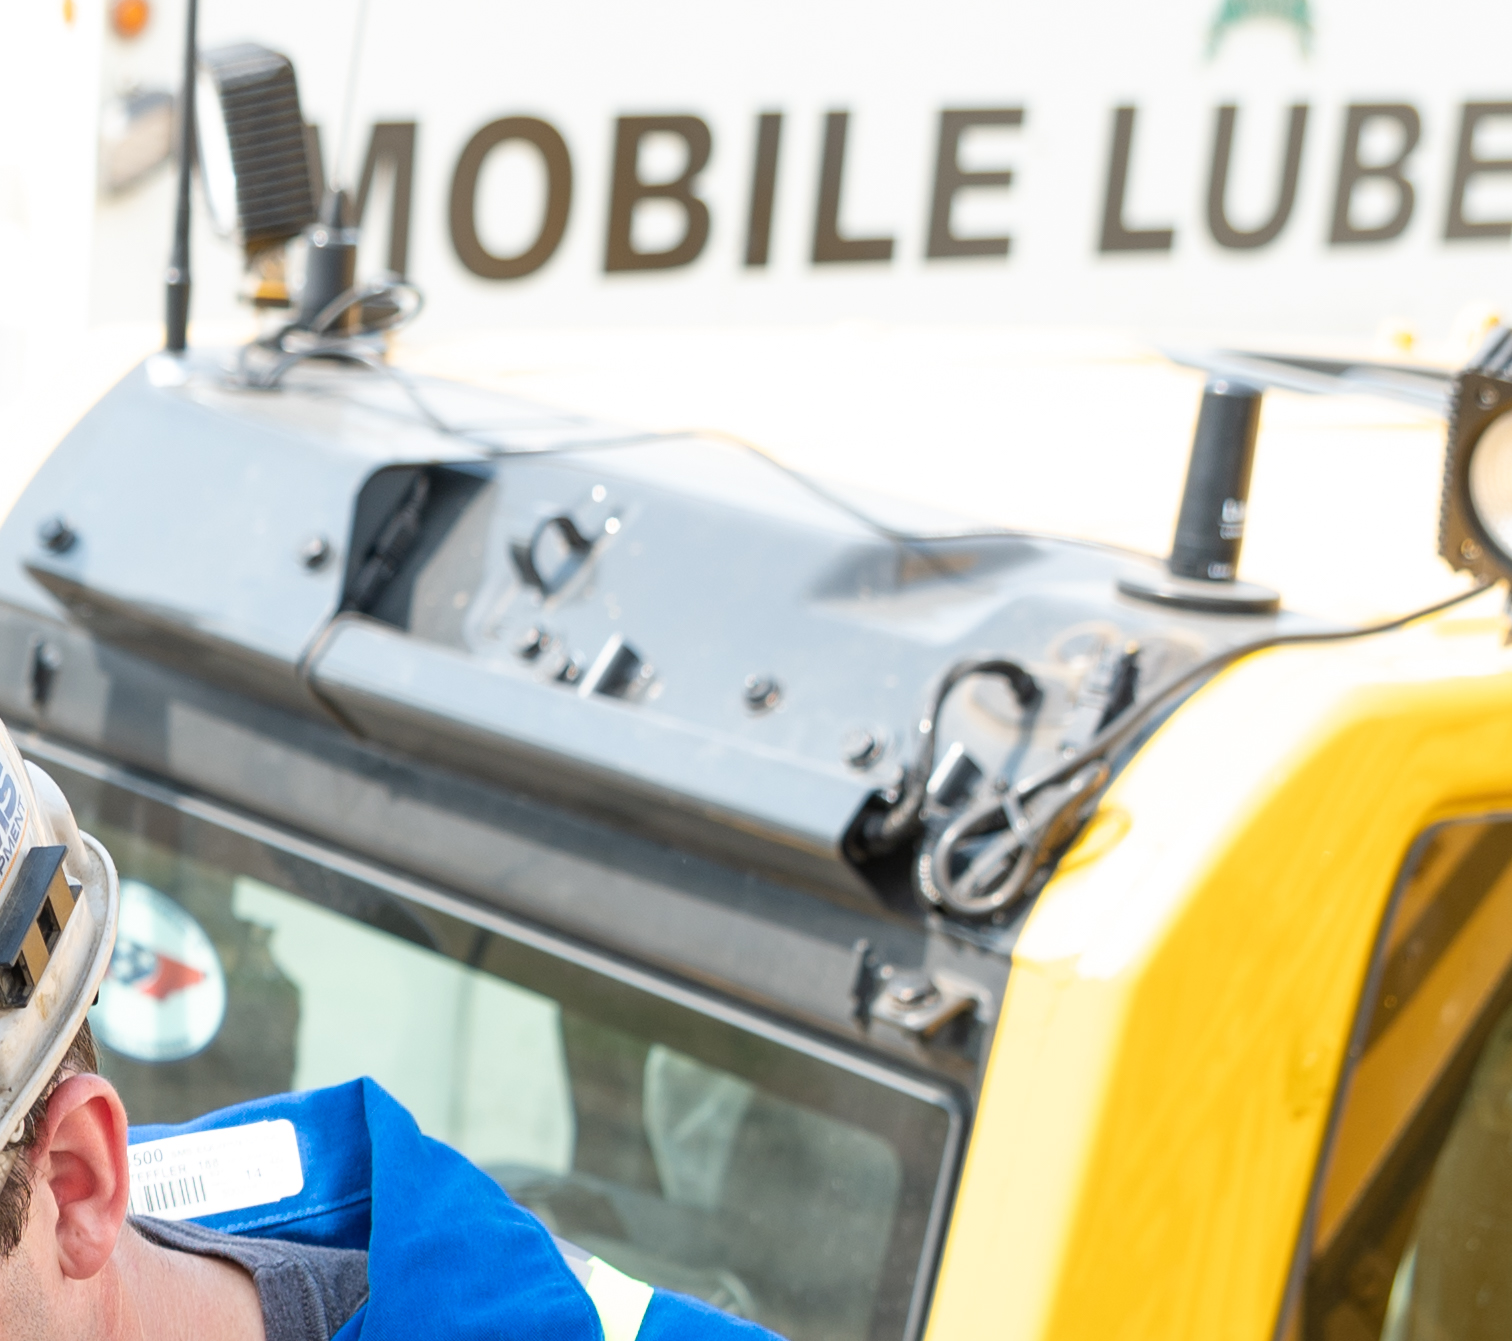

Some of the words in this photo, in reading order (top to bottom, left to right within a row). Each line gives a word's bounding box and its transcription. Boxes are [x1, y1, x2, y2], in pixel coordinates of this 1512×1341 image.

[302, 105, 1026, 282] MOBILE
[127, 1148, 163, 1168] 500
[131, 1163, 187, 1184] TEFFLER
